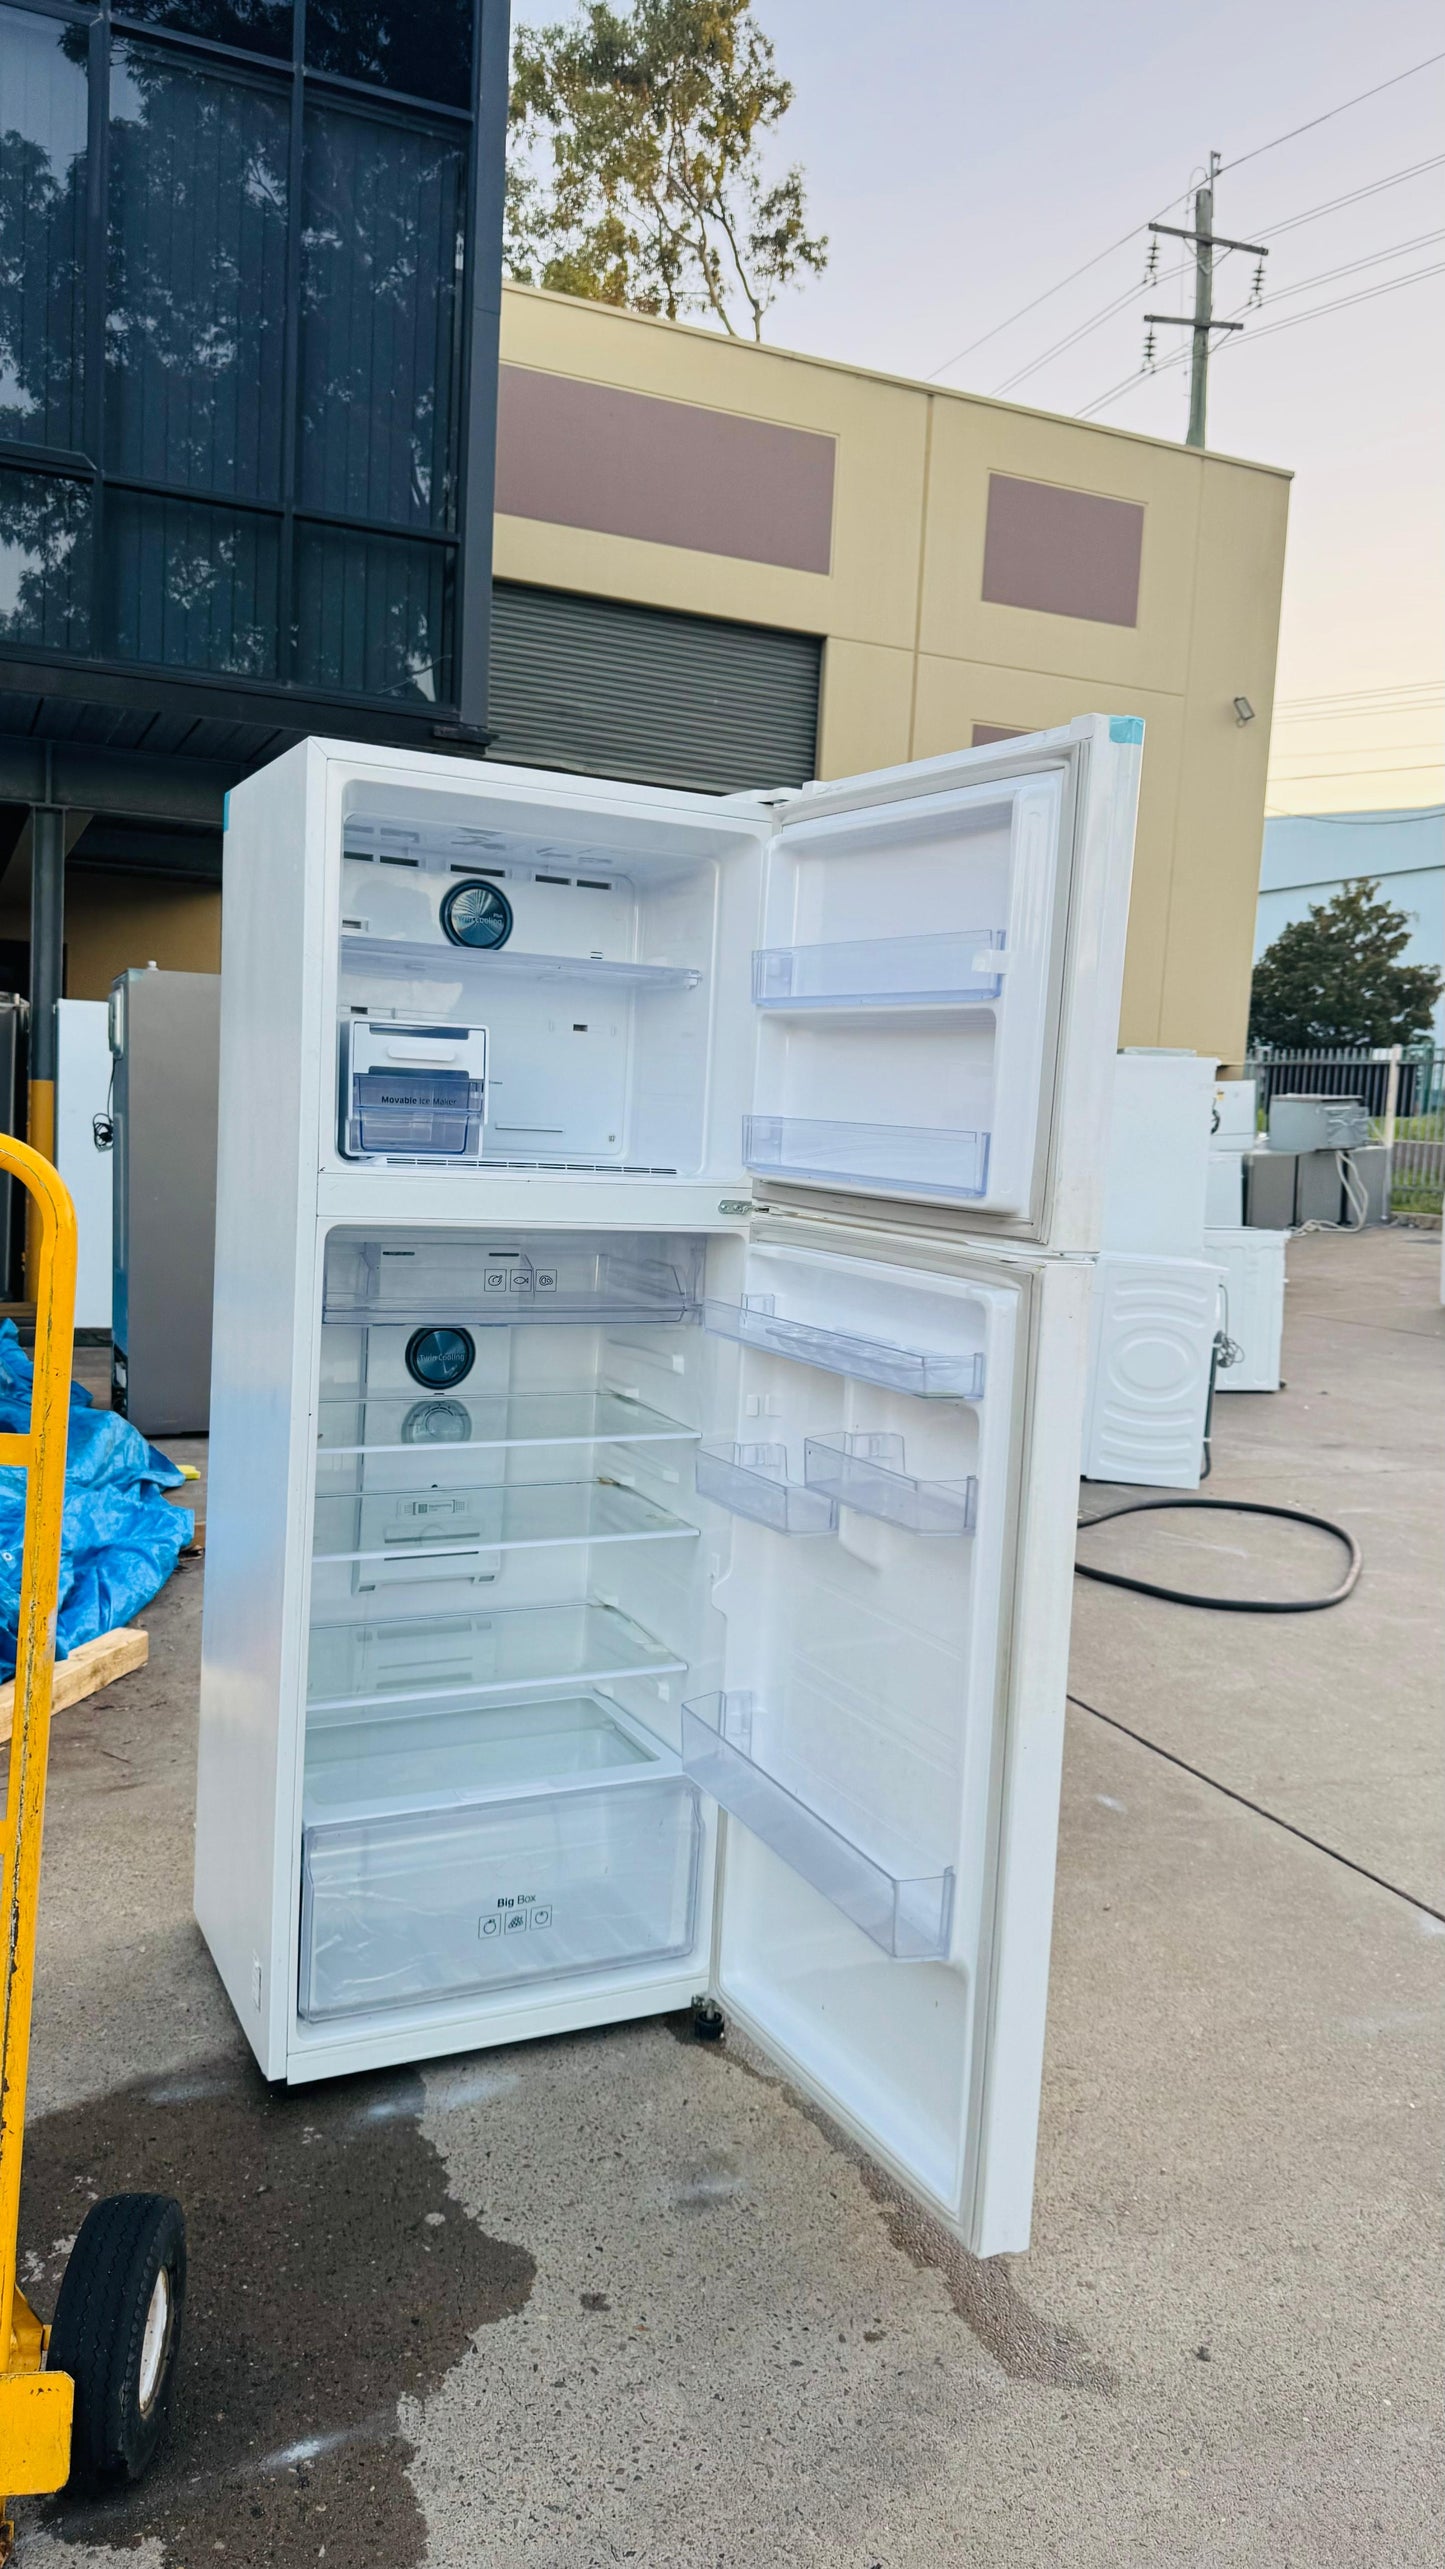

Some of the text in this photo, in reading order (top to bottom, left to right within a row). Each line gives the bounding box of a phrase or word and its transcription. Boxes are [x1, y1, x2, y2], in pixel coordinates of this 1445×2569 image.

[381, 1096, 457, 1106] Movable Ice Maker
[419, 1352, 465, 1362] Twin Cooling
[497, 1894, 536, 1908] Big Box
